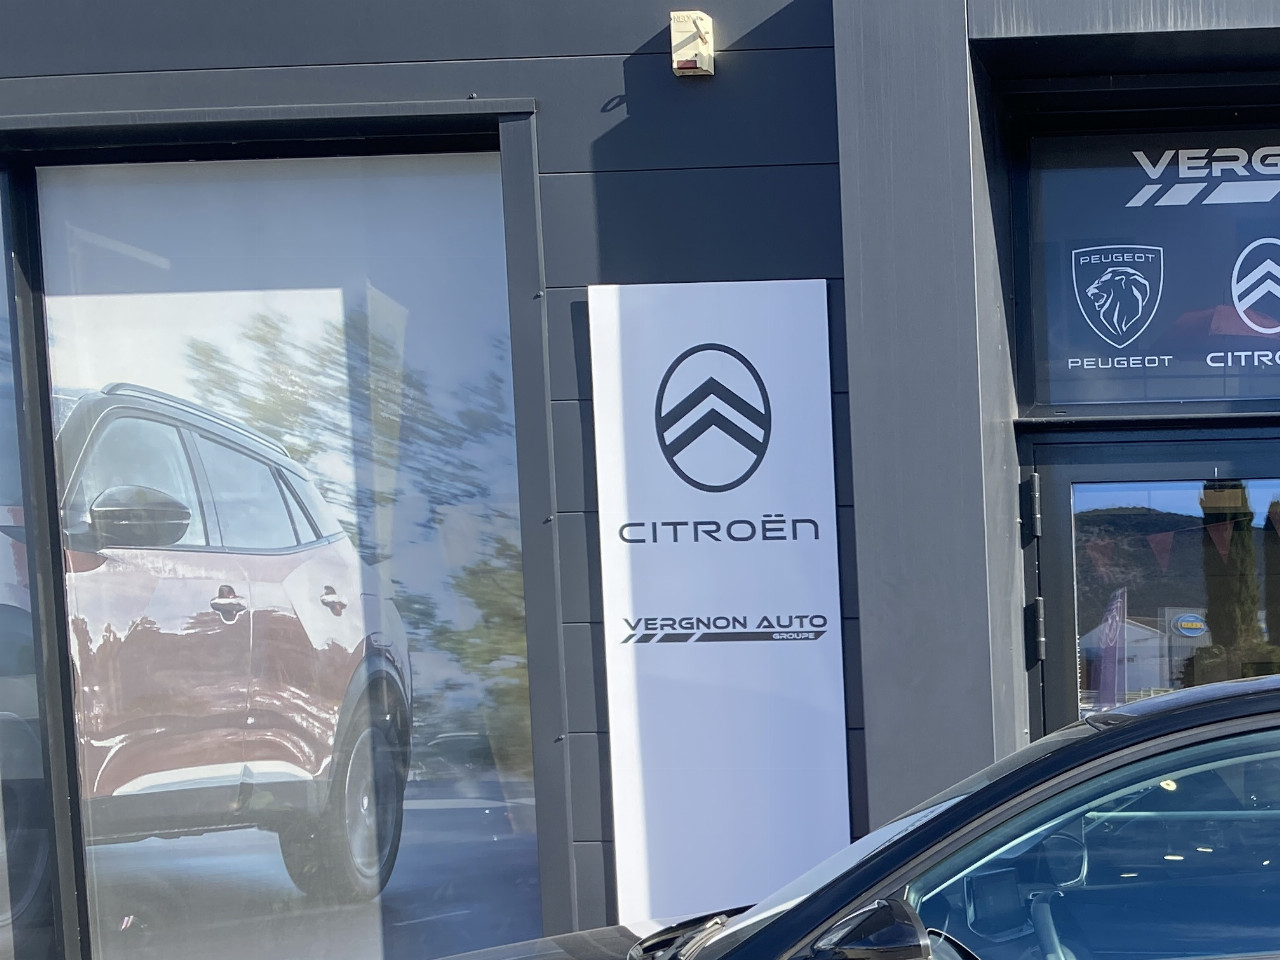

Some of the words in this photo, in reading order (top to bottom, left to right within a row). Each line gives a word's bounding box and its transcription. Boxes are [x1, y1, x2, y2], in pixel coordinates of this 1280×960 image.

[1079, 253, 1156, 264] PEUGEOT
[1068, 355, 1173, 369] PEUGEOT
[622, 616, 748, 631] VERGNON
[755, 614, 828, 629] AUTO
[772, 631, 816, 640] GROUPE
